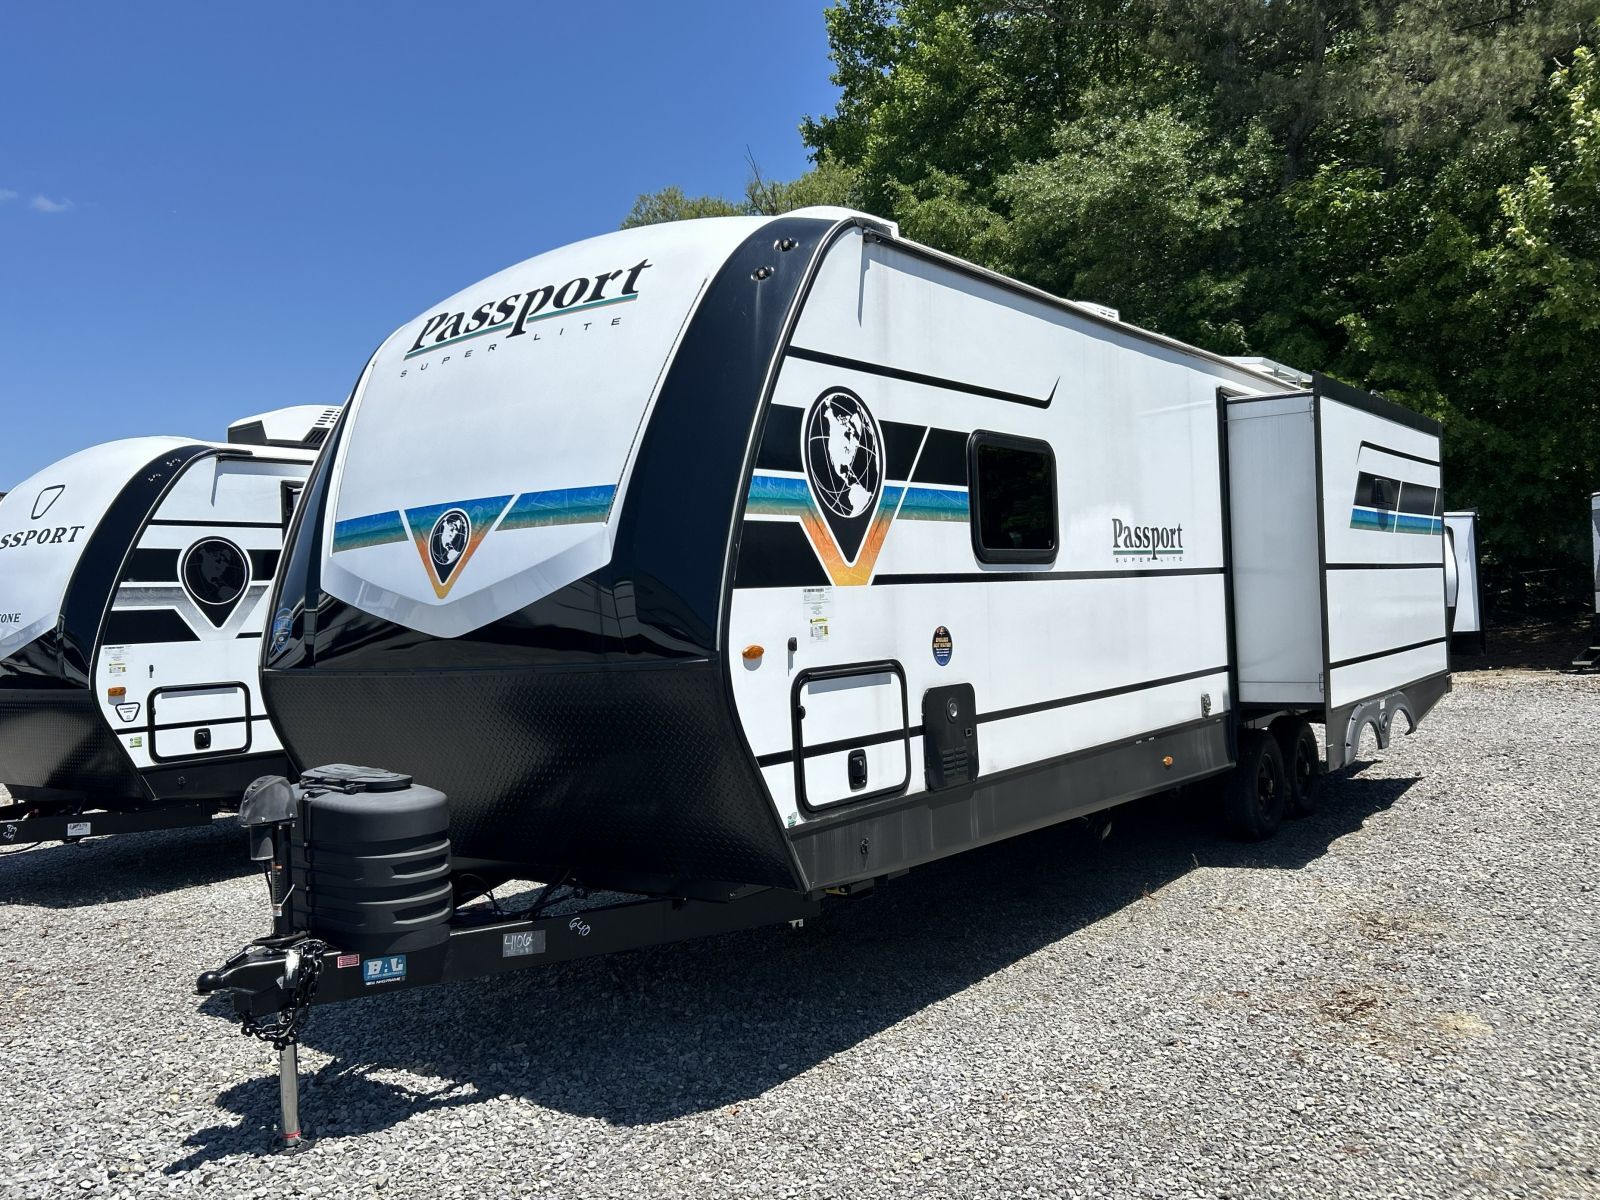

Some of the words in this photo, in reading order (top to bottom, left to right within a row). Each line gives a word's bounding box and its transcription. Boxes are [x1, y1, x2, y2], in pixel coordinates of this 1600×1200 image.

[407, 259, 653, 353] Passport
[400, 343, 497, 378] SUPER
[533, 317, 622, 341] LITE
[1112, 518, 1183, 560] Passport
[568, 917, 591, 936] 640
[367, 957, 404, 976] BAL
